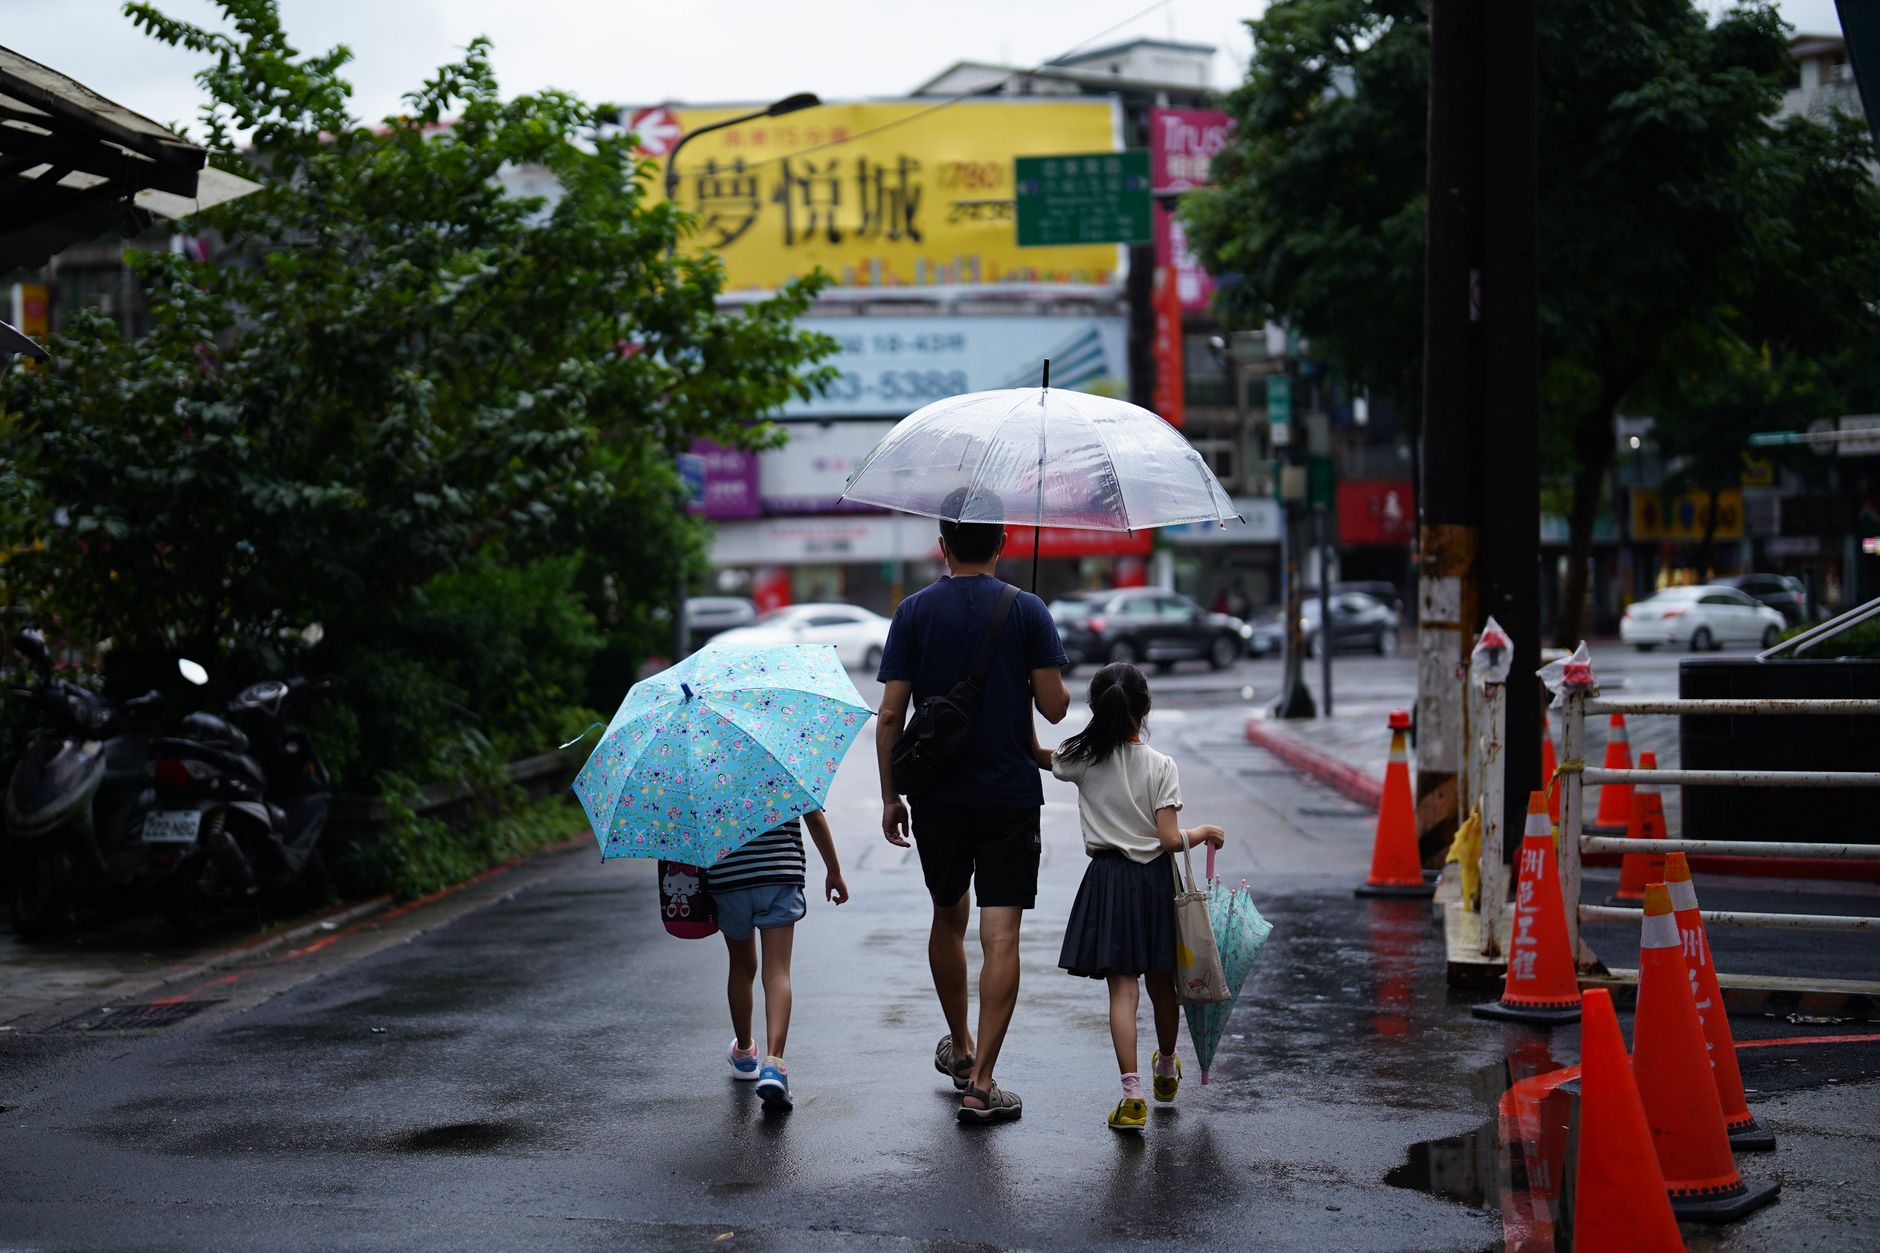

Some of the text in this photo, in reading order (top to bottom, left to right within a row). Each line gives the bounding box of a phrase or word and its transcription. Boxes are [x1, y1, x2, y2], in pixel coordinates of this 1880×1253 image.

[1161, 116, 1238, 155] Trus
[695, 155, 923, 247] 夢悅城
